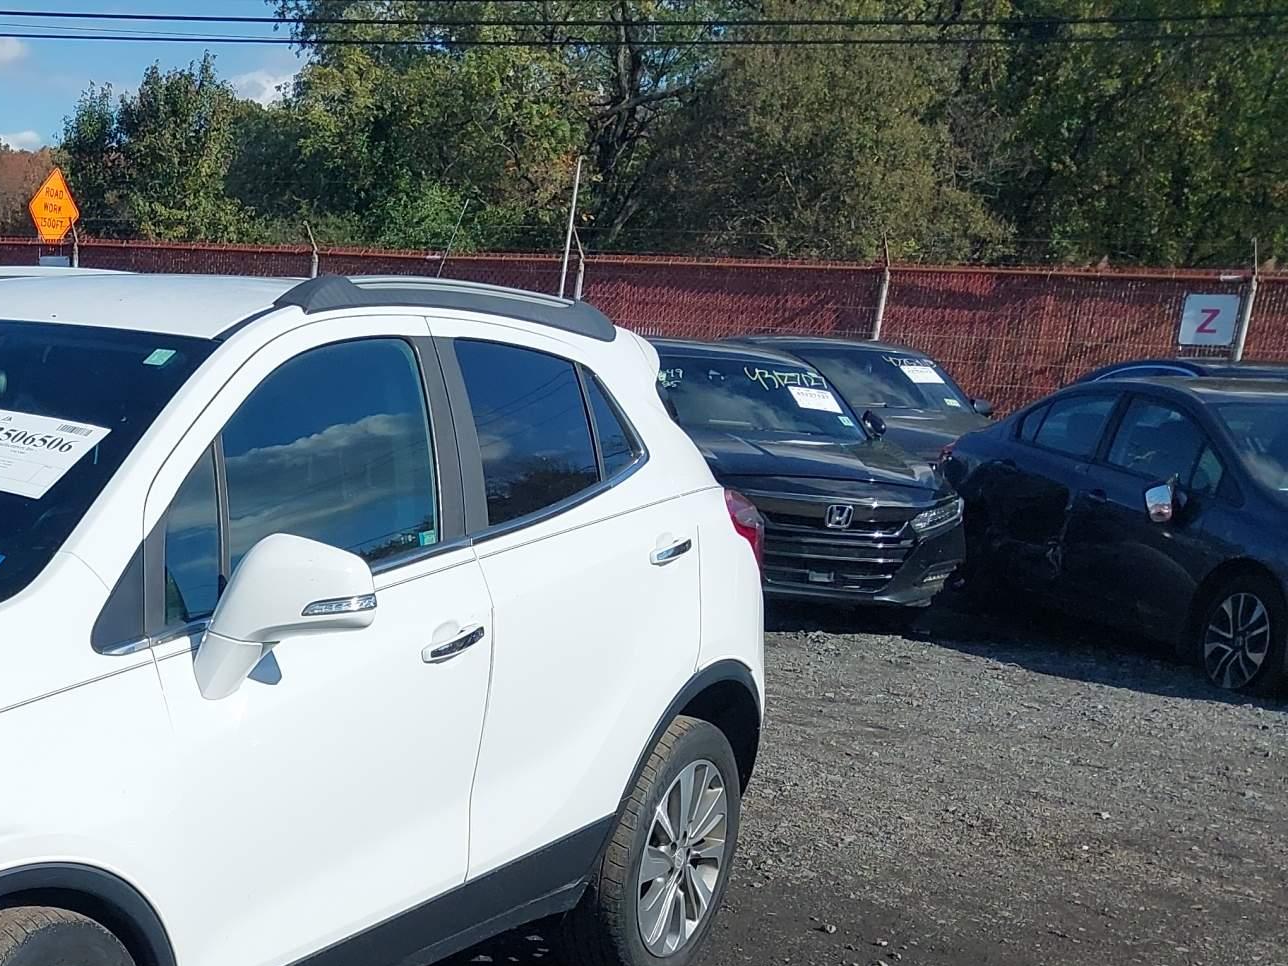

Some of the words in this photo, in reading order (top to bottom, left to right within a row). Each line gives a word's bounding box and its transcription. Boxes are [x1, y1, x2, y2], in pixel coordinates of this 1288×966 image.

[45, 187, 64, 200] ROAD
[43, 202, 62, 214] WORK
[1196, 308, 1221, 334] Z
